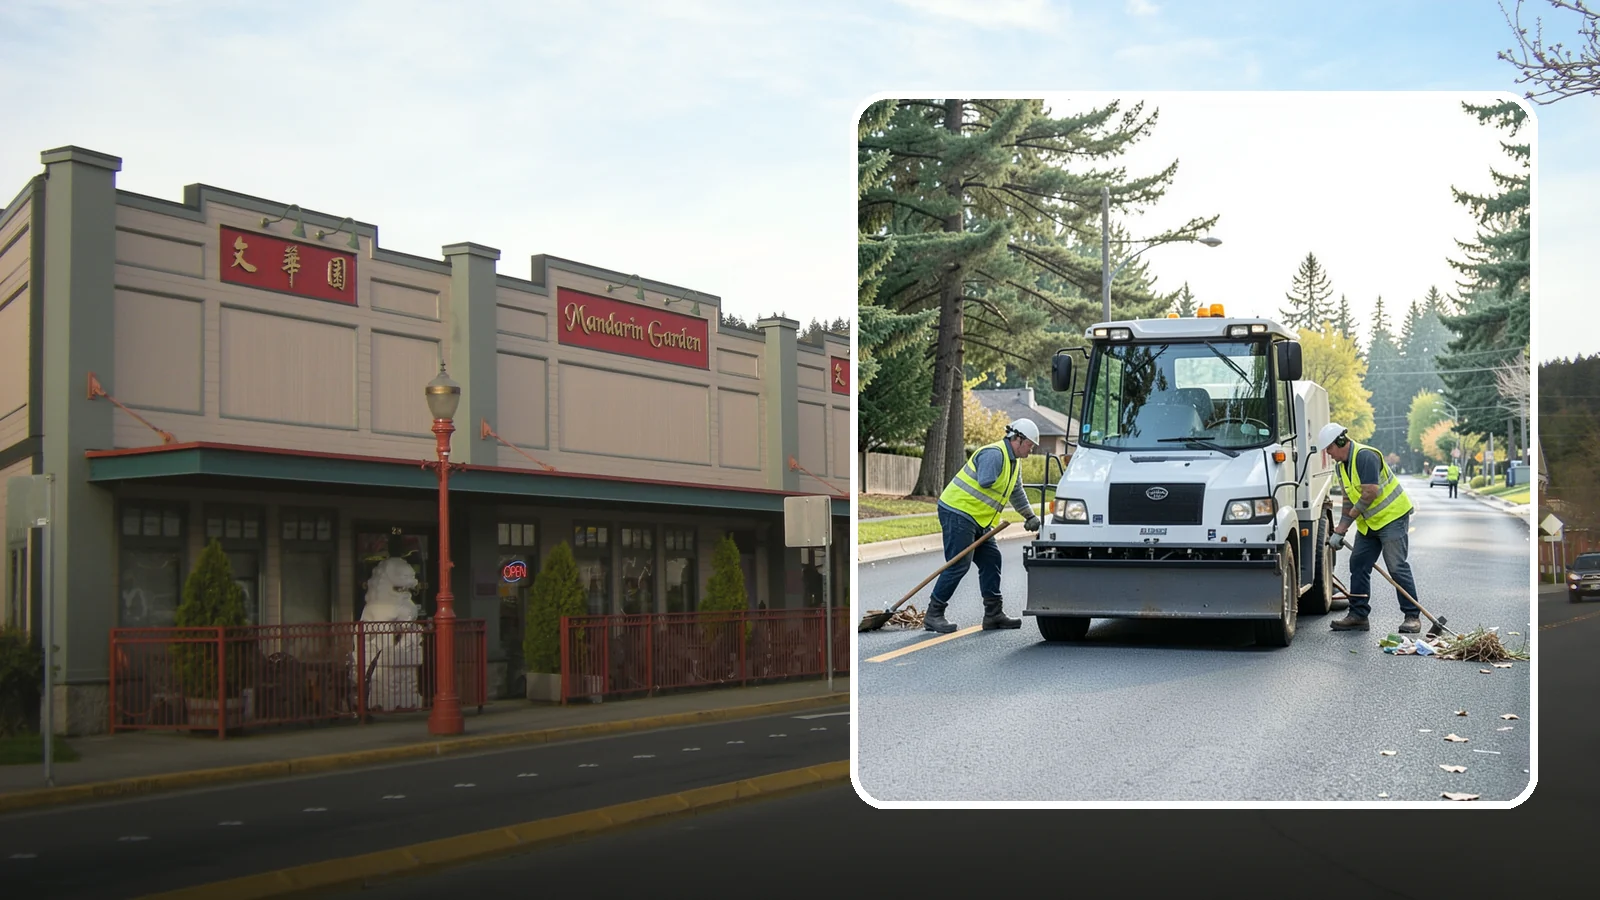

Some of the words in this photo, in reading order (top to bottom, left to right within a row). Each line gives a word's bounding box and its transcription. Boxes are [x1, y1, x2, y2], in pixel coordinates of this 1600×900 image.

[231, 236, 346, 290] 文華園
[564, 302, 644, 340] Mandarin
[648, 320, 701, 352] Garden
[503, 565, 527, 578] OPEN
